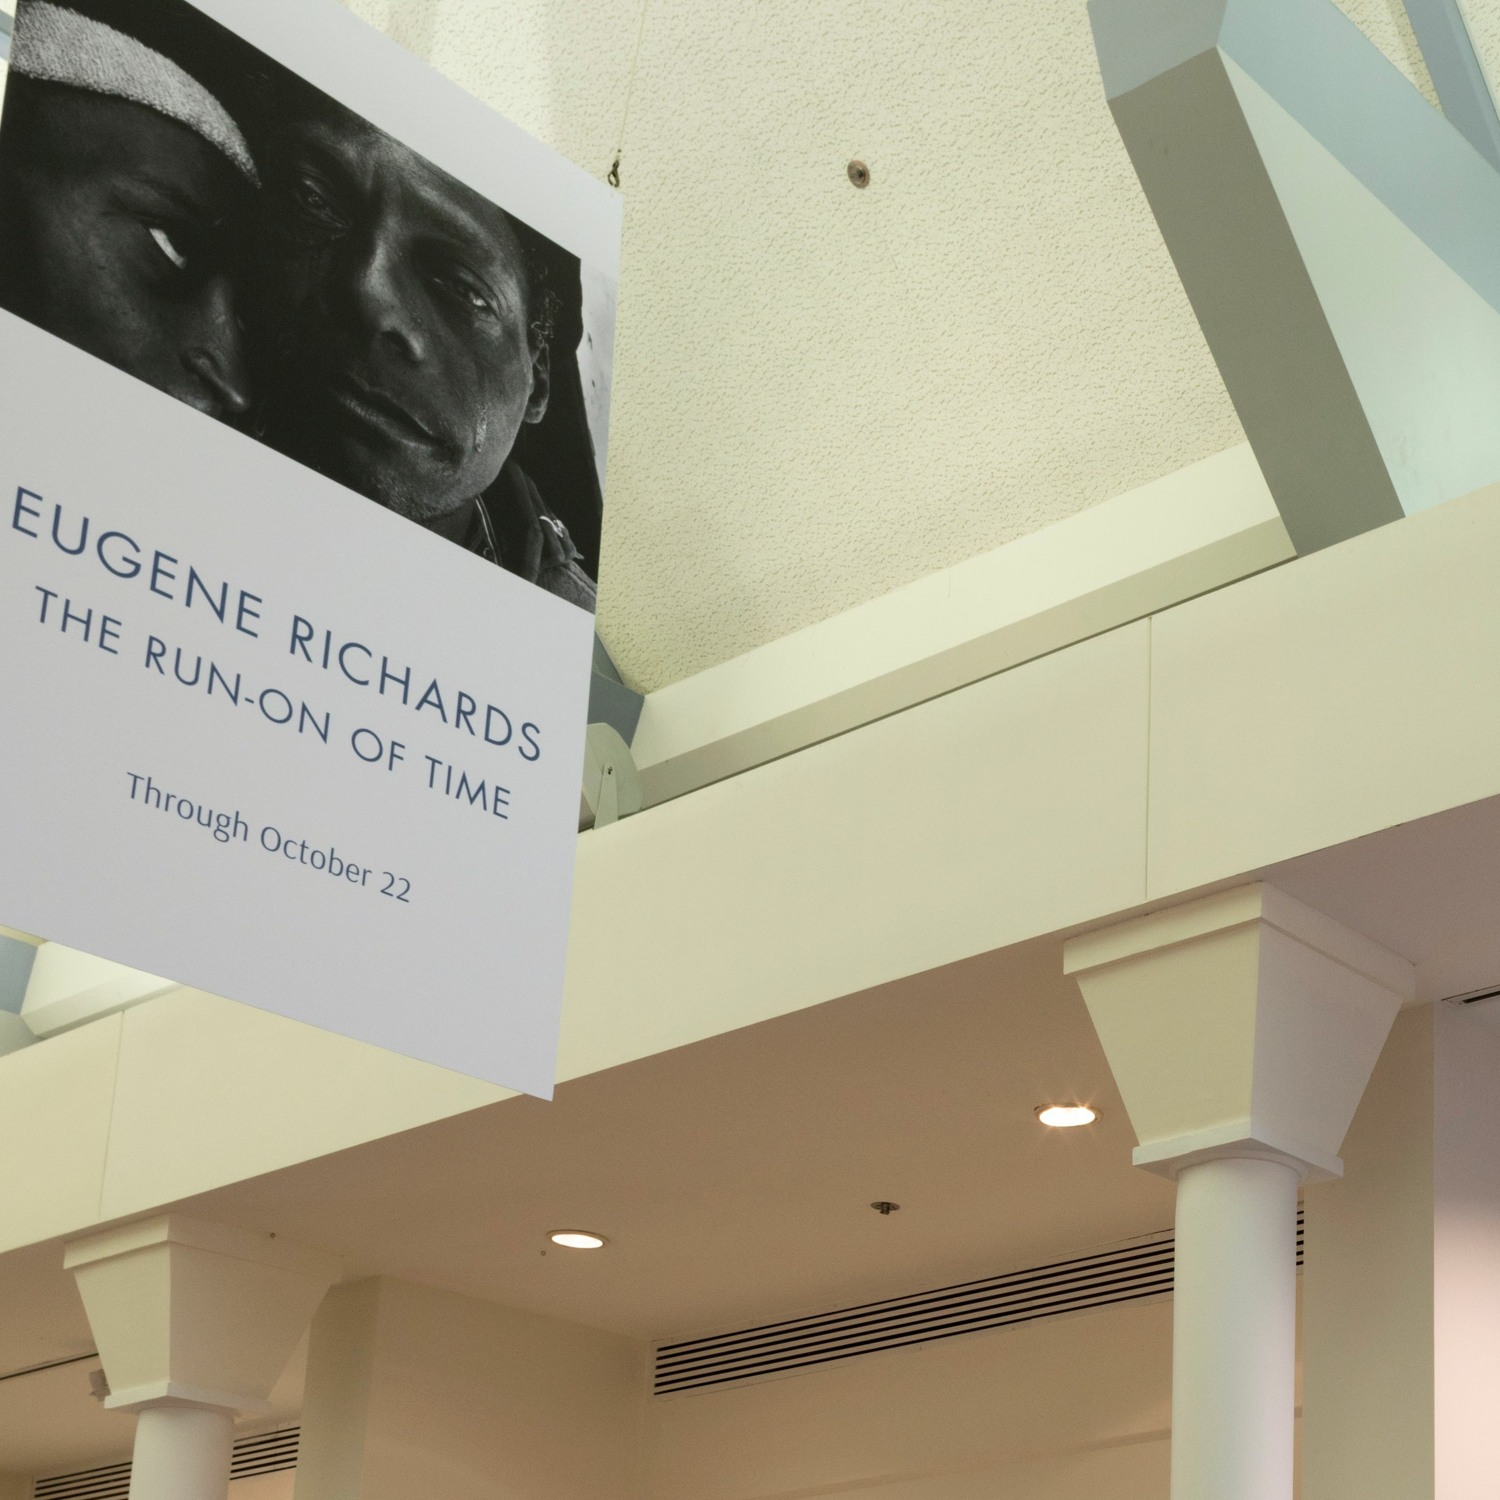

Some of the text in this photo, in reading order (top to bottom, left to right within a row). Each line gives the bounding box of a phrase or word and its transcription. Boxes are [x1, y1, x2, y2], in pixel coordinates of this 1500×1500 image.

[11, 486, 543, 763] EUGENE RICHARDS
[35, 585, 512, 821] THE RUN-ON OF TIME
[126, 772, 412, 904] Through October 22
